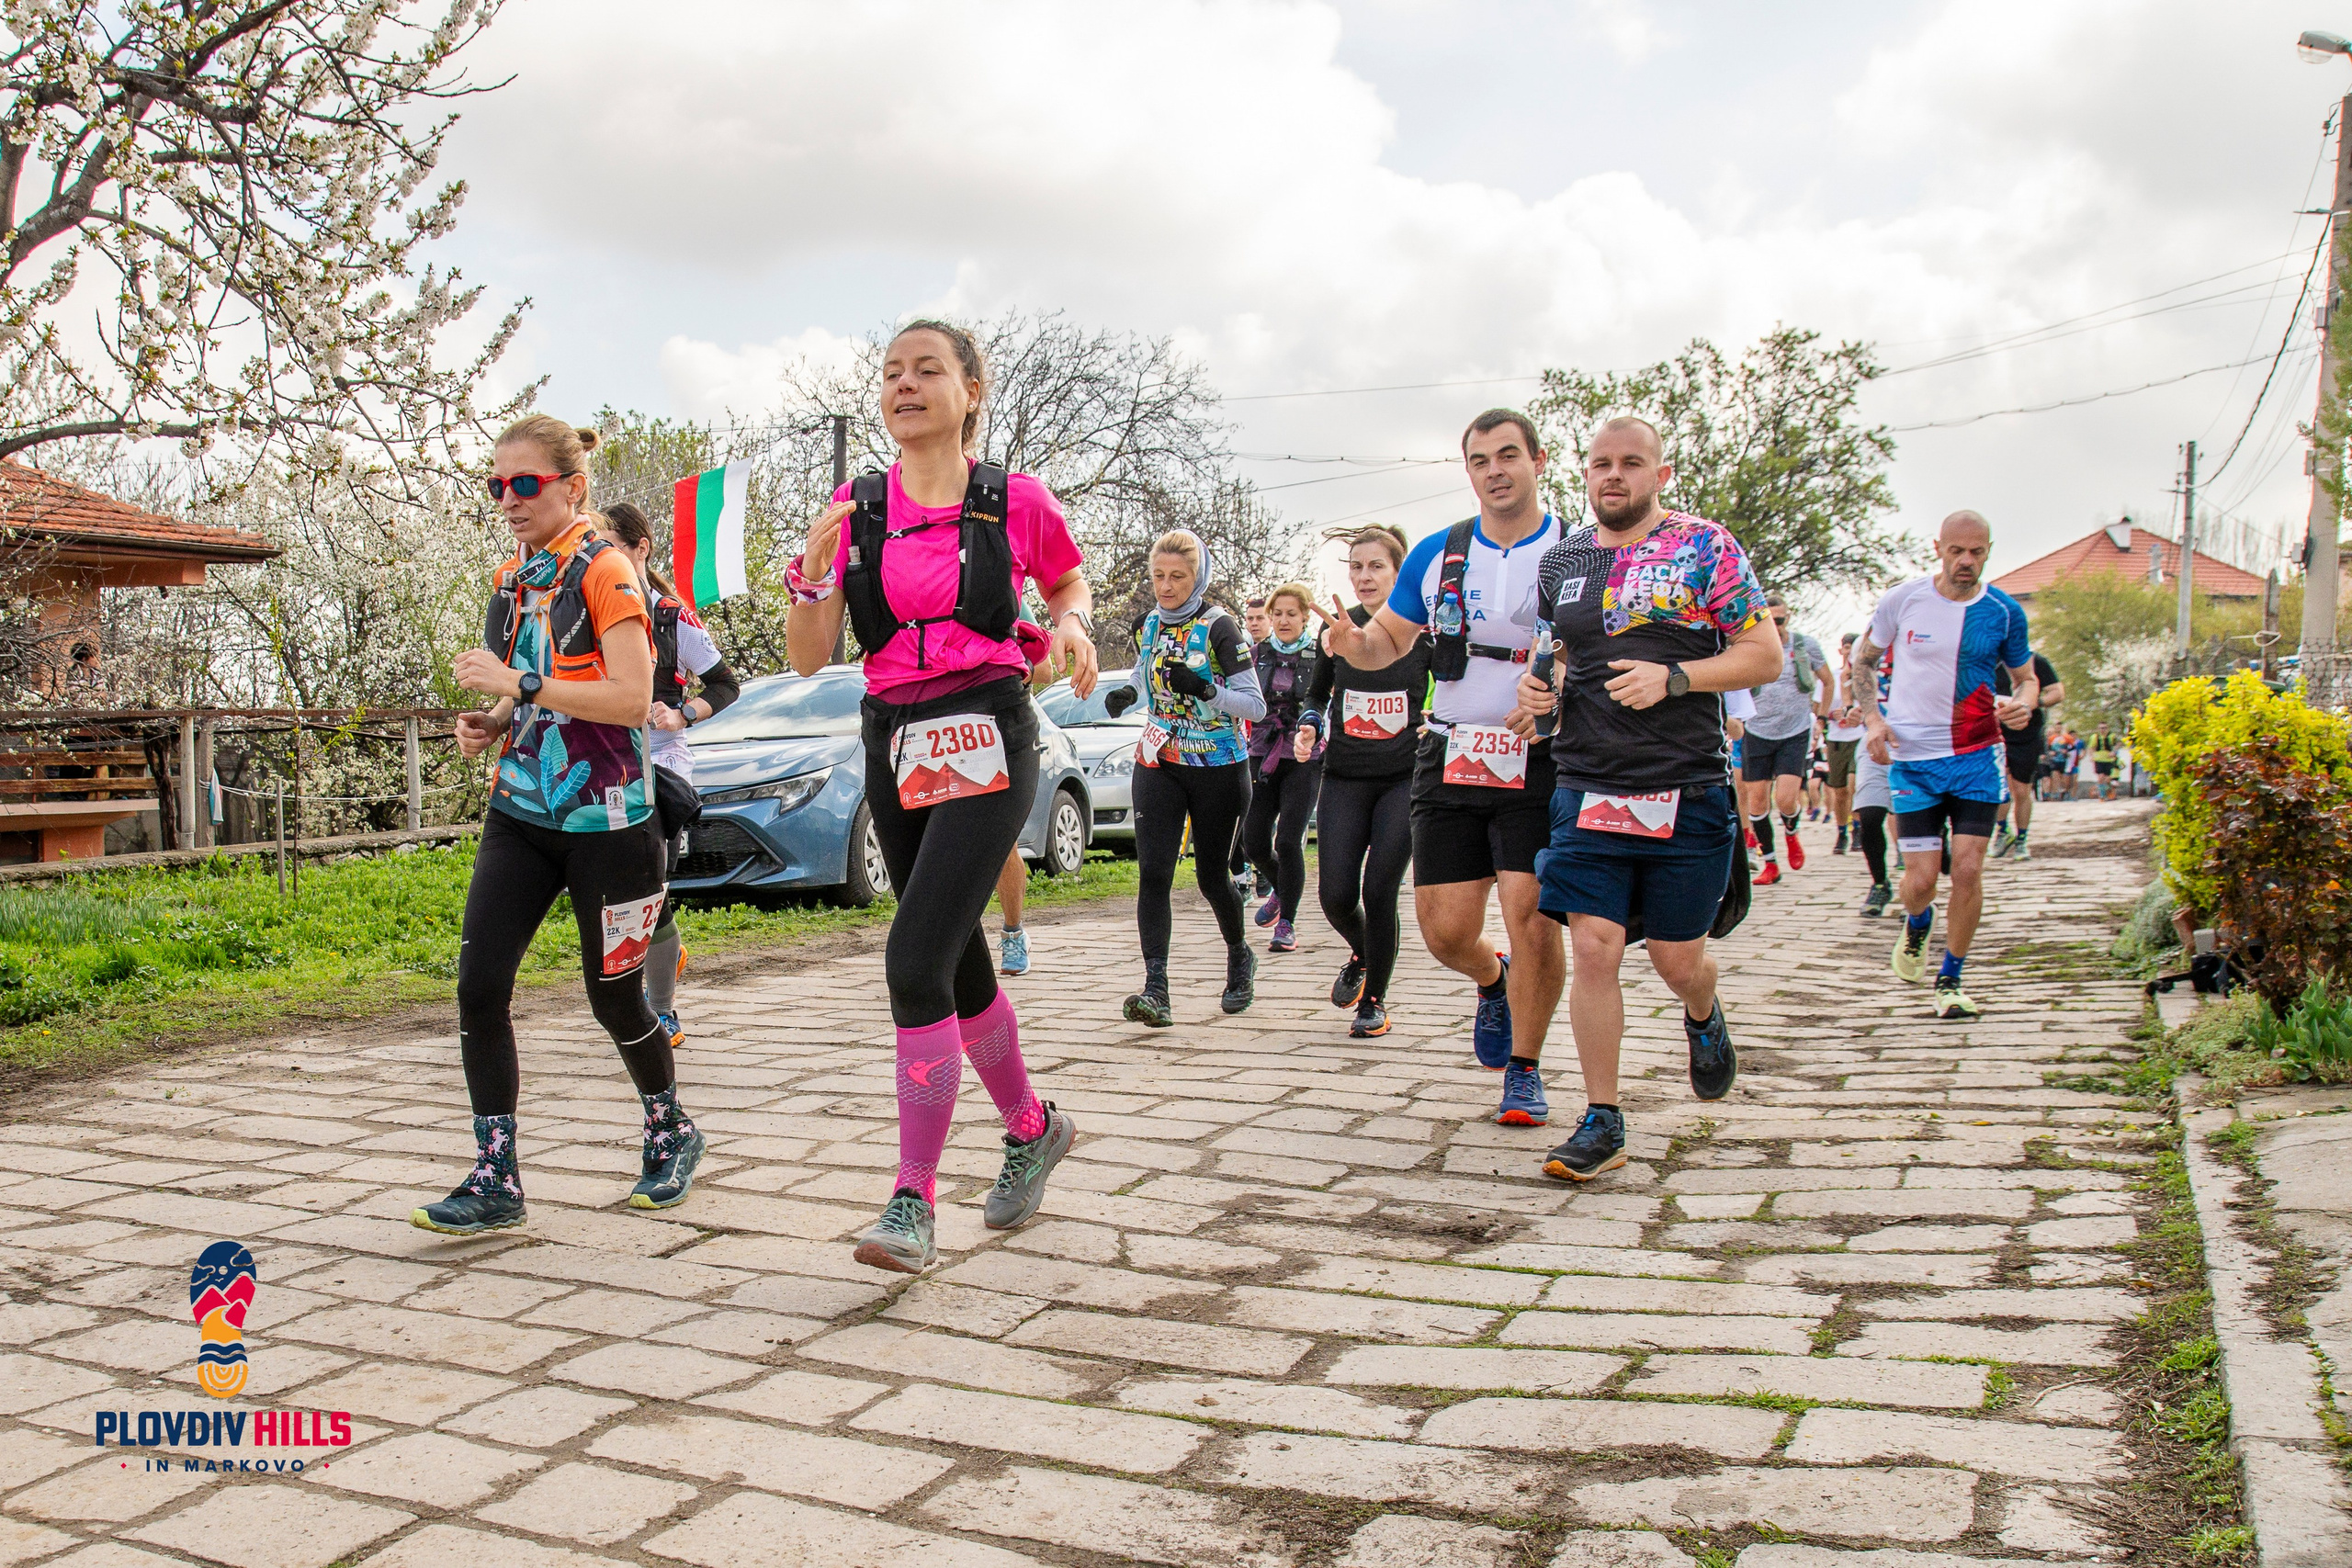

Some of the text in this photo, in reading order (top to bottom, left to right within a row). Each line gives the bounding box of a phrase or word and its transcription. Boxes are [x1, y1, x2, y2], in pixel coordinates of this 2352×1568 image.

[971, 511, 1000, 523] KIPRUN
[1625, 565, 1686, 581] БАСИ
[1623, 580, 1687, 598] КЕФА
[1367, 696, 1404, 715] 2103
[926, 723, 996, 759] 2380
[1178, 739, 1217, 753] RUNNERS
[1472, 731, 1523, 757] 2354
[607, 926, 620, 936] 22K
